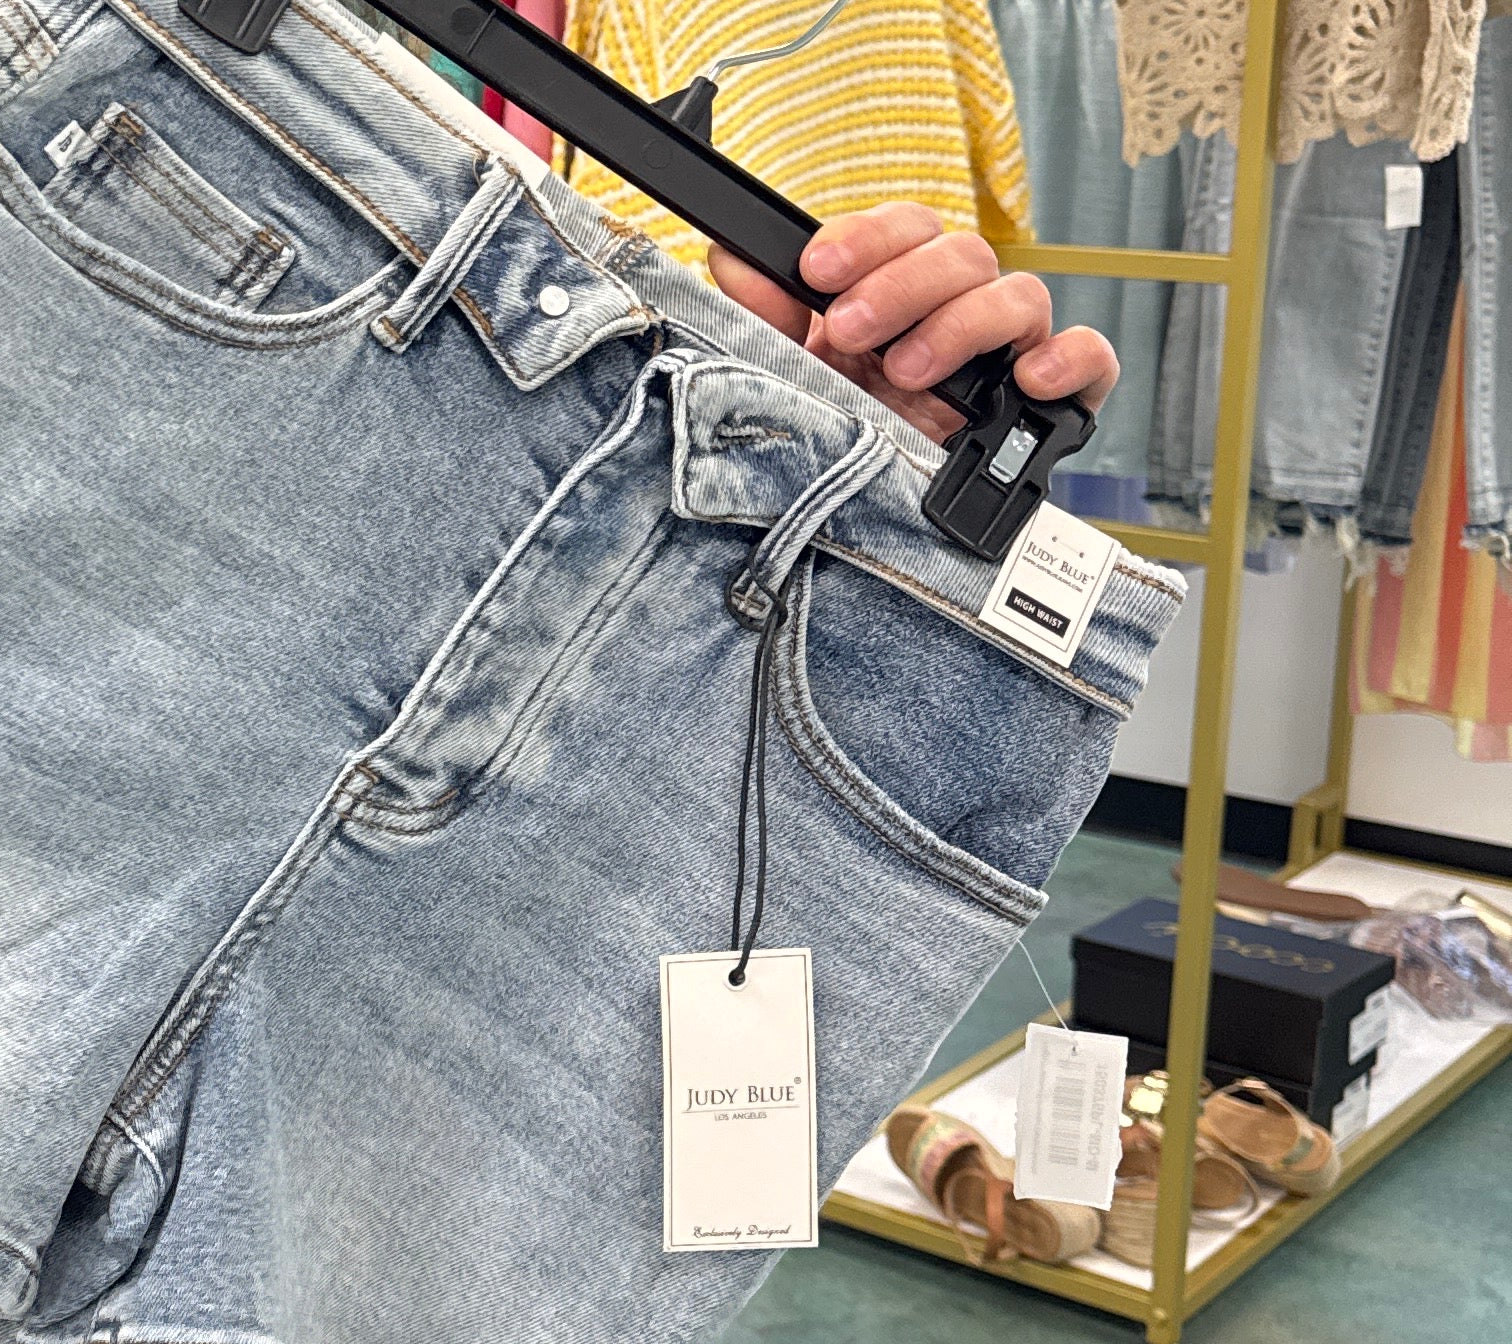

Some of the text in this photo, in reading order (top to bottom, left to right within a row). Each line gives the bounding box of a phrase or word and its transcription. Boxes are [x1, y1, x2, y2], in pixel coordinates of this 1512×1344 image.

[1024, 541, 1058, 565] JUDY
[1060, 561, 1089, 584] BLUE
[1013, 596, 1064, 629] HIGH WAIST
[687, 1088, 738, 1110] JUDY
